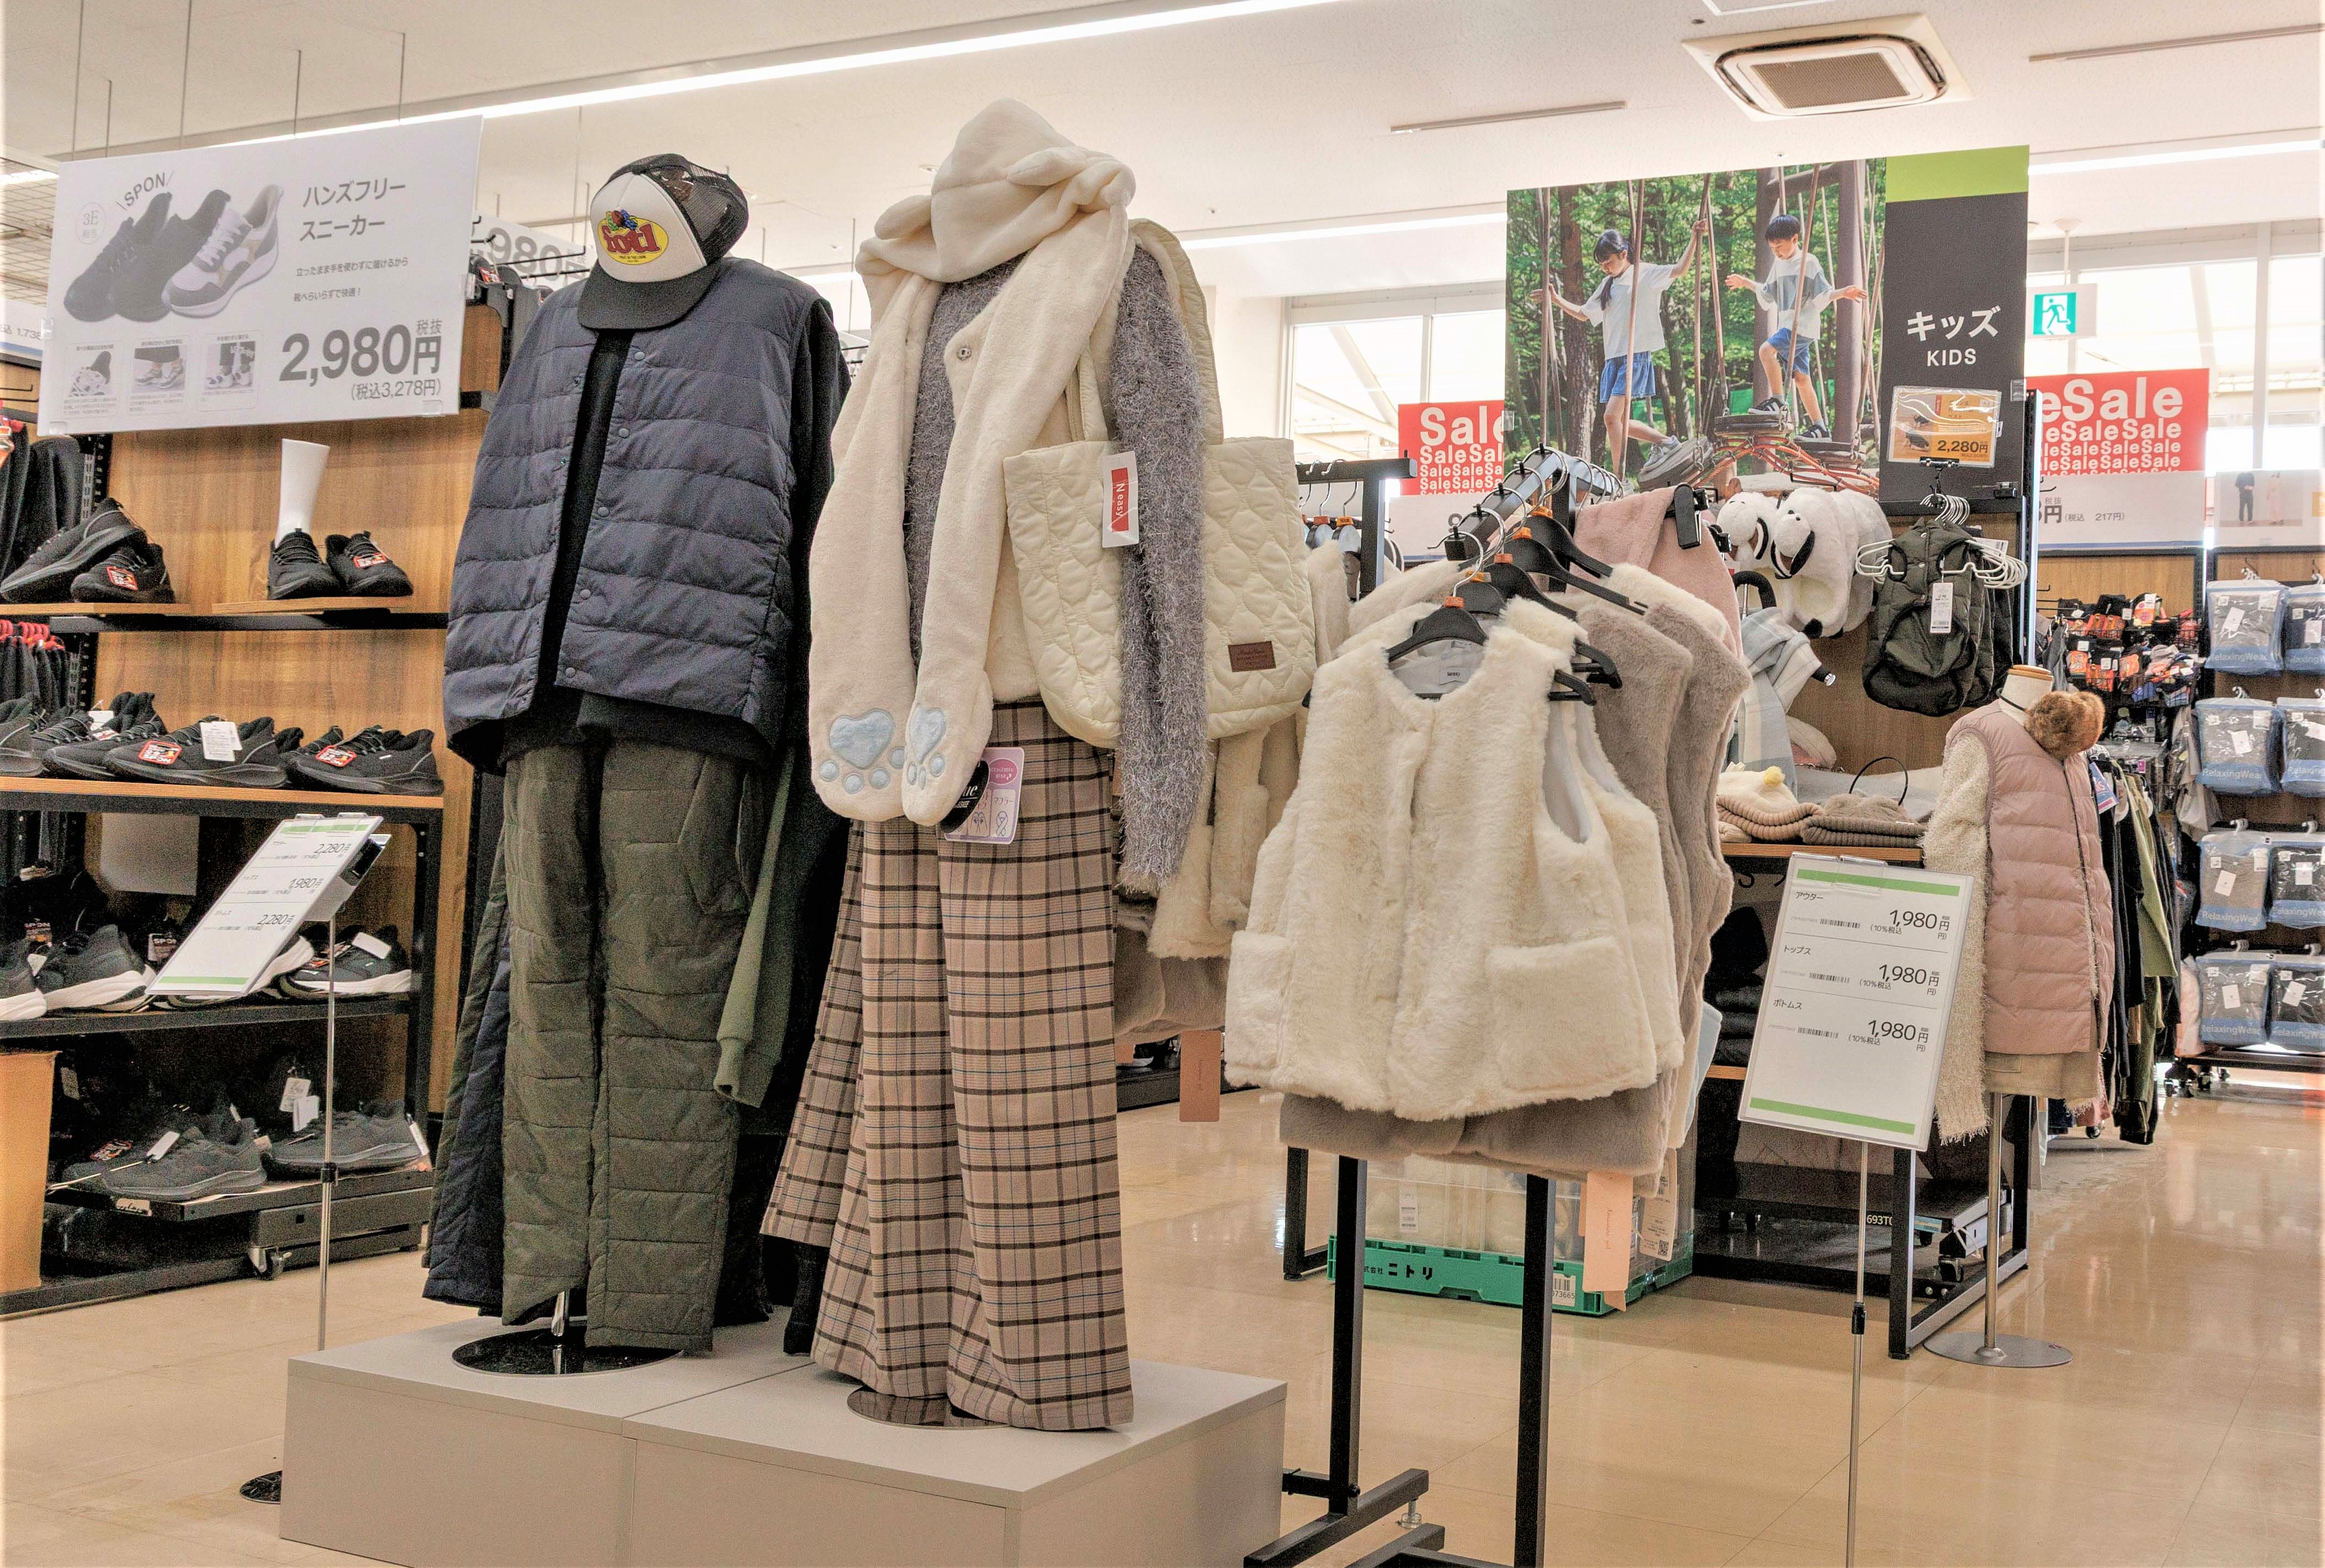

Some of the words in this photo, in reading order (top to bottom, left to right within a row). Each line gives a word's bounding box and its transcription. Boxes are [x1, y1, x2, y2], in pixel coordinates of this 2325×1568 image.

[124, 172, 165, 207] SPON
[303, 178, 406, 207] ハンズフリー
[299, 214, 385, 241] スニーカー
[602, 224, 661, 253] fotl
[416, 319, 443, 335] 税抜
[1907, 305, 2001, 342] キッズ
[279, 324, 442, 387] 2,980円
[1927, 348, 1976, 367] KIDS
[351, 378, 441, 400] (税込3,278円)
[2039, 500, 2062, 524] 円
[1795, 891, 1824, 901] アウター
[1784, 945, 1811, 956] トップス
[1773, 998, 1802, 1010] ボトムス
[1389, 1262, 1433, 1280] ニトリ
